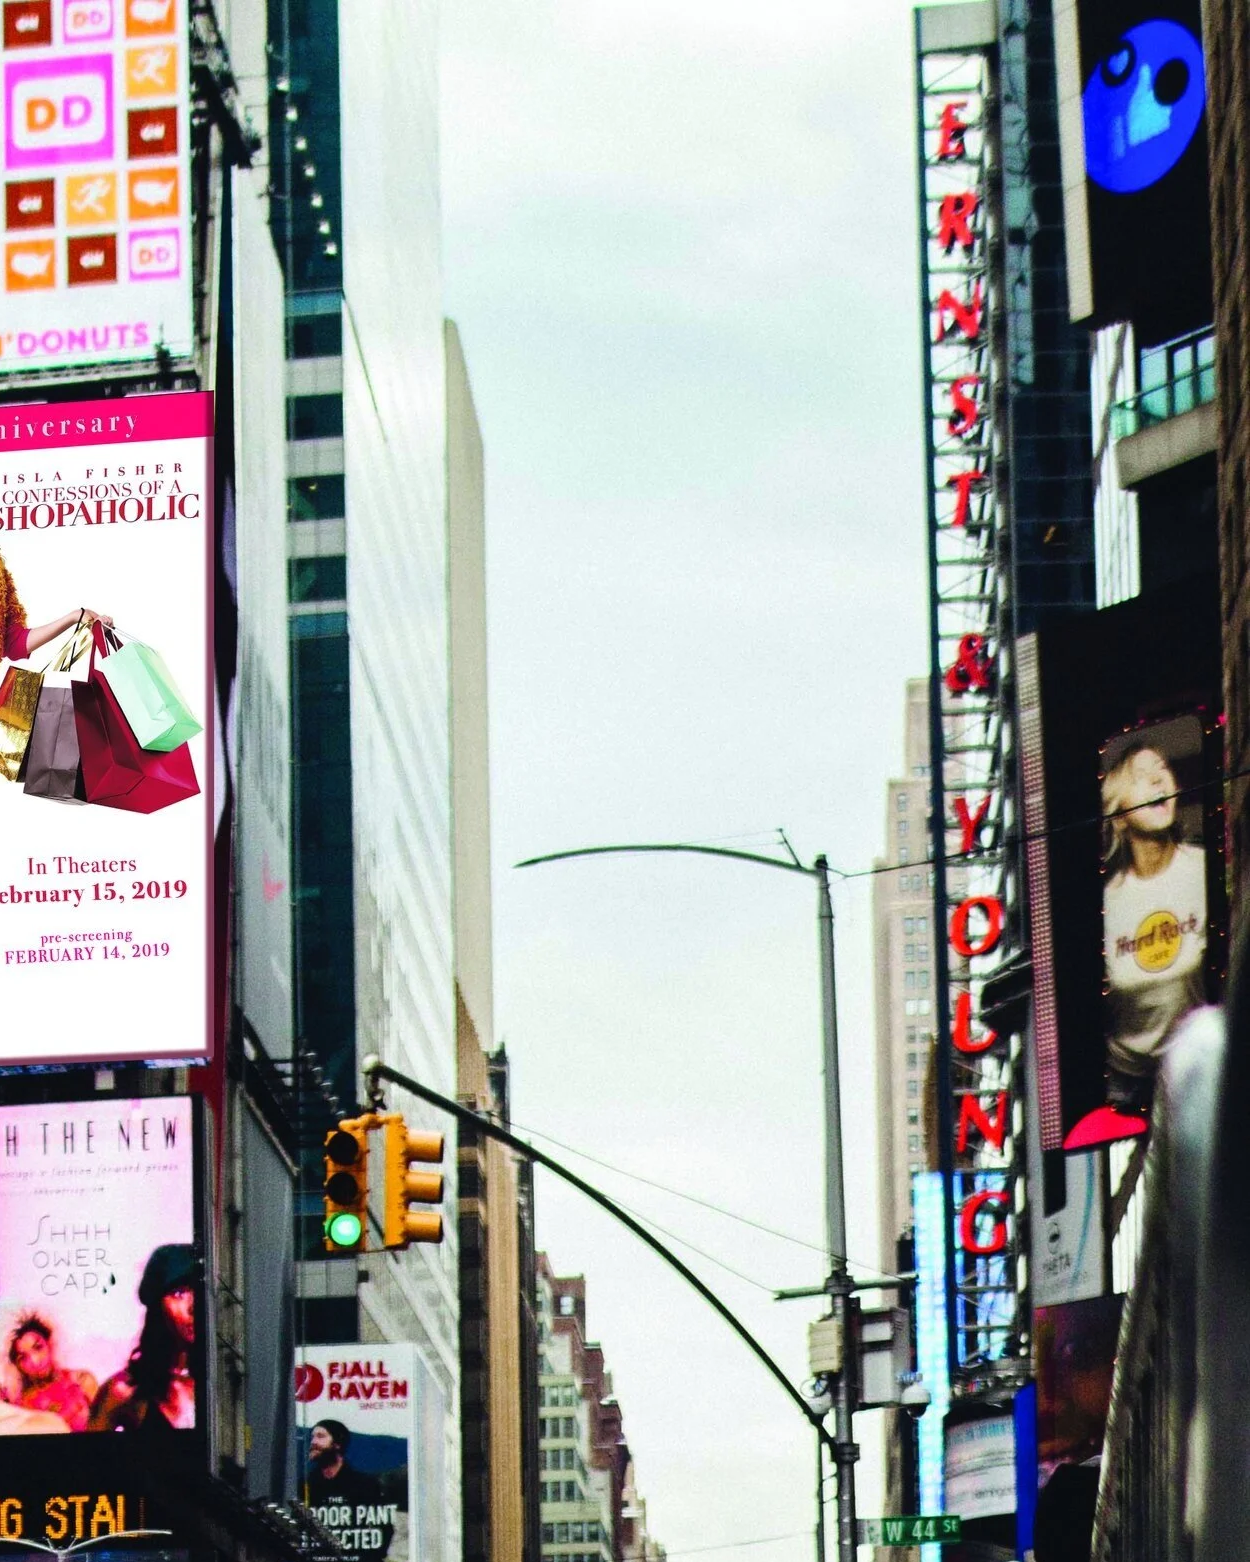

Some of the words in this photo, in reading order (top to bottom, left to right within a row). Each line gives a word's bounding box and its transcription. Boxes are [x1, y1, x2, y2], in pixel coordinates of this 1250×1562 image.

[26, 95, 92, 132] DD
[935, 101, 983, 527] ERNST
[17, 322, 148, 356] DONUTS
[3, 471, 63, 485] ISLA
[85, 462, 184, 479] FISHER
[1, 482, 133, 506] CONFESSIONS
[138, 480, 161, 496] OF
[161, 479, 183, 494] A
[944, 634, 994, 692] &
[27, 857, 48, 876] In
[53, 856, 138, 875] Theaters
[92, 881, 126, 904] 15,
[132, 879, 188, 900] 2019
[40, 929, 133, 947] pre-screening
[5, 946, 95, 965] FEBRUARY
[102, 945, 126, 961] 14,
[132, 942, 171, 959] 2019
[39, 1120, 95, 1156] THE
[117, 1115, 179, 1152] NEW
[32, 1248, 112, 1270] OWER
[40, 1272, 99, 1298] CAP
[328, 1380, 408, 1401] RAVEN
[356, 1503, 398, 1526] PANT
[886, 1520, 903, 1542] W
[912, 1519, 936, 1541] 44
